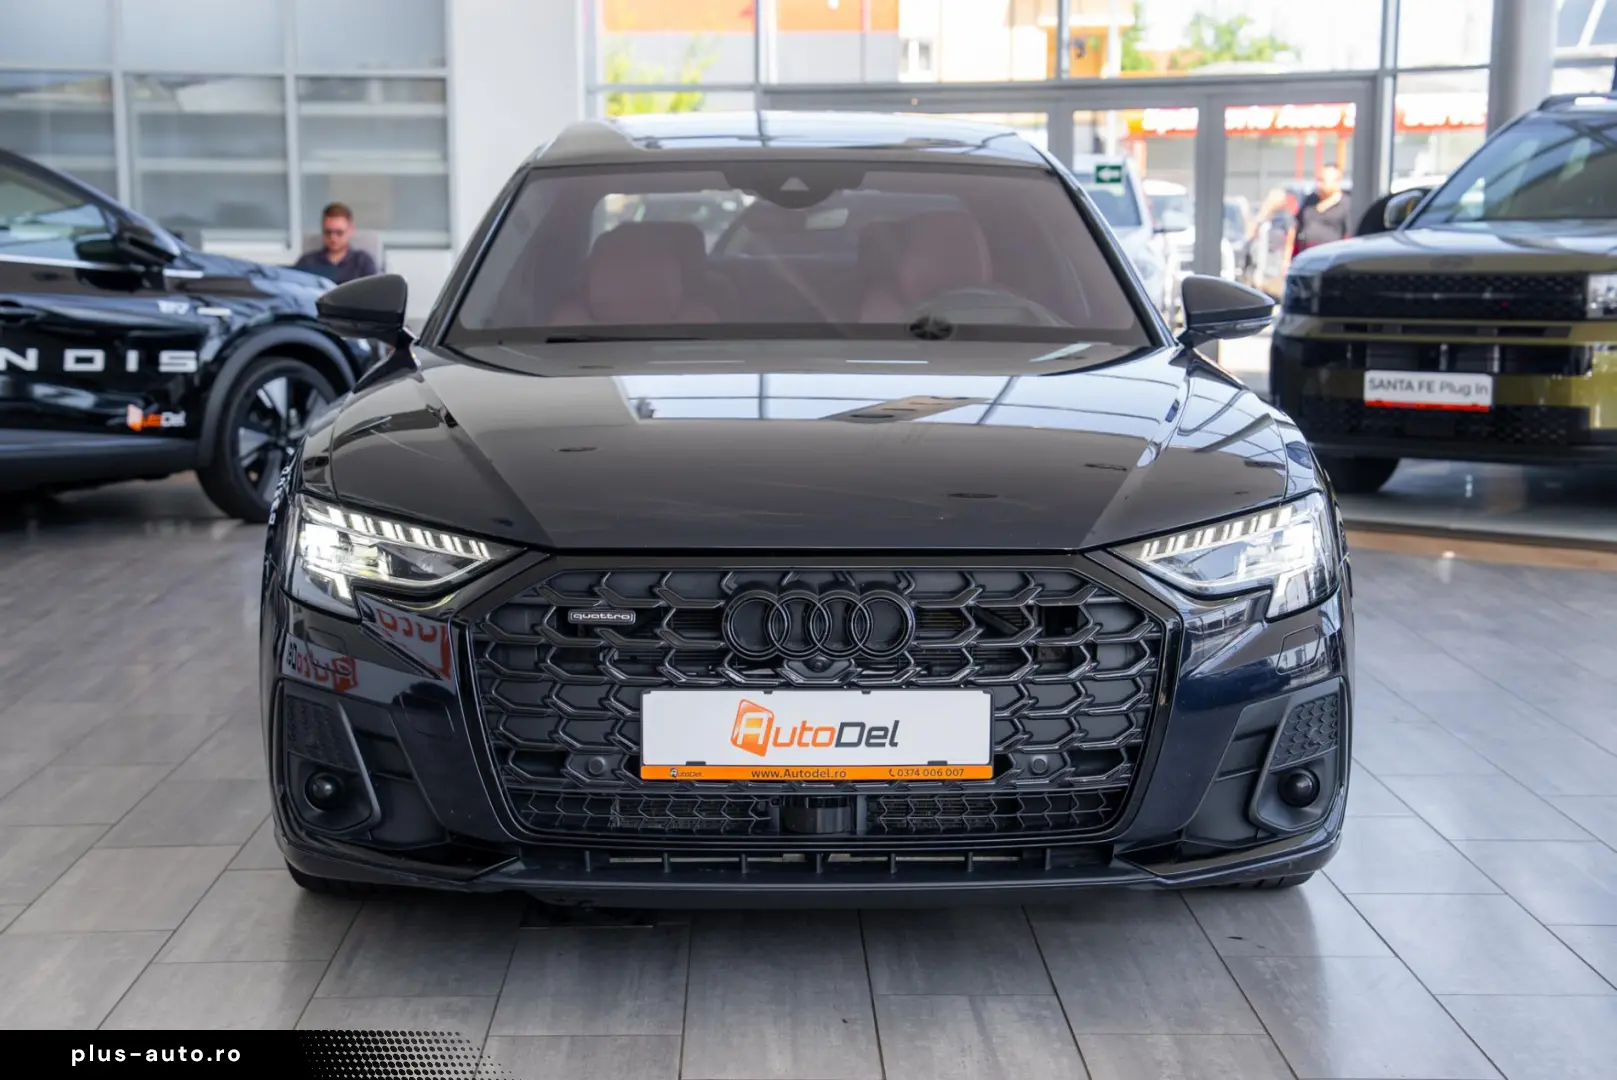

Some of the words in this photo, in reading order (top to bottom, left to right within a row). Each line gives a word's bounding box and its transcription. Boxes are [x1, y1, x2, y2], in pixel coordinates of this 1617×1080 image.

[1368, 378, 1415, 392] SANTA
[1418, 380, 1436, 393] FE
[1440, 381, 1472, 397] Plug
[734, 708, 900, 749] AutoDel
[751, 768, 847, 779] www.Autodel.ro
[897, 768, 920, 777] 0374
[923, 768, 943, 777] 006
[945, 768, 965, 777] 007
